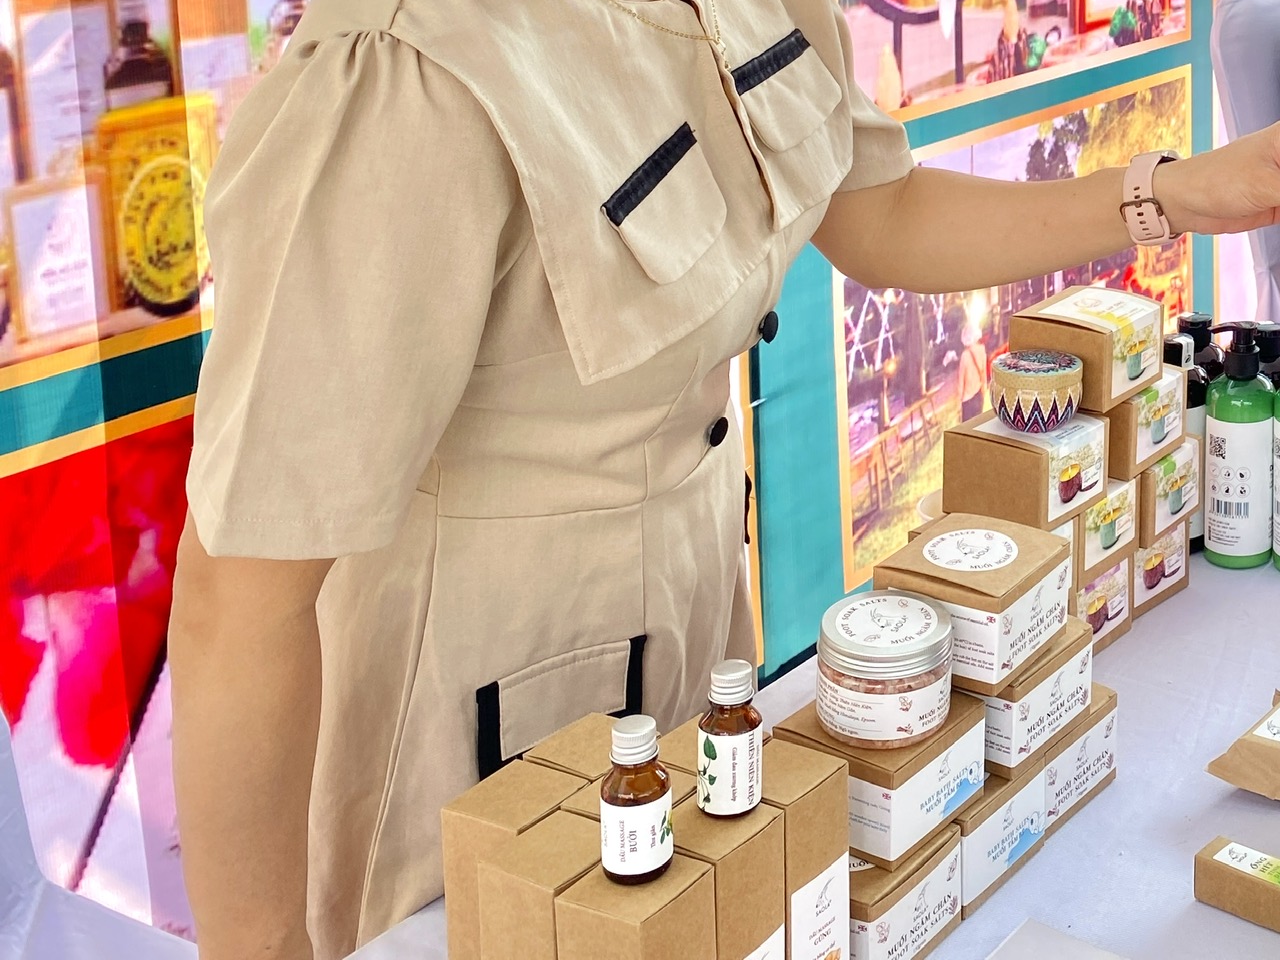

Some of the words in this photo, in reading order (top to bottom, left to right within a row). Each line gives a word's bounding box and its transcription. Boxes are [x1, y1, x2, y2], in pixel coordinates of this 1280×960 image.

[841, 606, 859, 621] SOAK
[860, 598, 887, 607] SALTS
[918, 607, 932, 621] CHÂN
[841, 623, 856, 638] FOOT
[916, 622, 932, 636] NGÂM
[1010, 631, 1026, 650] MUỐI
[1027, 615, 1045, 638] NGÂM
[1045, 600, 1061, 620] CHÂN
[1010, 642, 1027, 660] FOOT
[1028, 628, 1043, 645] SOAK
[1043, 615, 1060, 632] SALTS
[890, 635, 915, 645] MUỐI
[1027, 715, 1045, 735] MUỐI
[1046, 700, 1065, 720] NGÂM
[1067, 684, 1084, 703] CHÂN
[1030, 726, 1046, 743] FOOT
[1047, 713, 1063, 729] SOAK
[1064, 697, 1081, 714] SALTS
[1055, 780, 1072, 800] MUỐI
[1073, 764, 1091, 785] NGÂM
[1092, 749, 1109, 767] CHÂN
[1058, 790, 1073, 809] FOOT
[1075, 776, 1090, 793] SOAK
[1091, 760, 1107, 778] SALTS
[920, 792, 936, 810] BABY
[936, 781, 951, 798] BATH
[627, 830, 637, 852] BƯỞI
[816, 902, 831, 917] SAOLA
[887, 933, 907, 959] MUỐI
[909, 914, 931, 936] NGÂM
[932, 891, 953, 916] CHÂN
[911, 927, 929, 945] SOAK
[930, 907, 950, 928] SALTS
